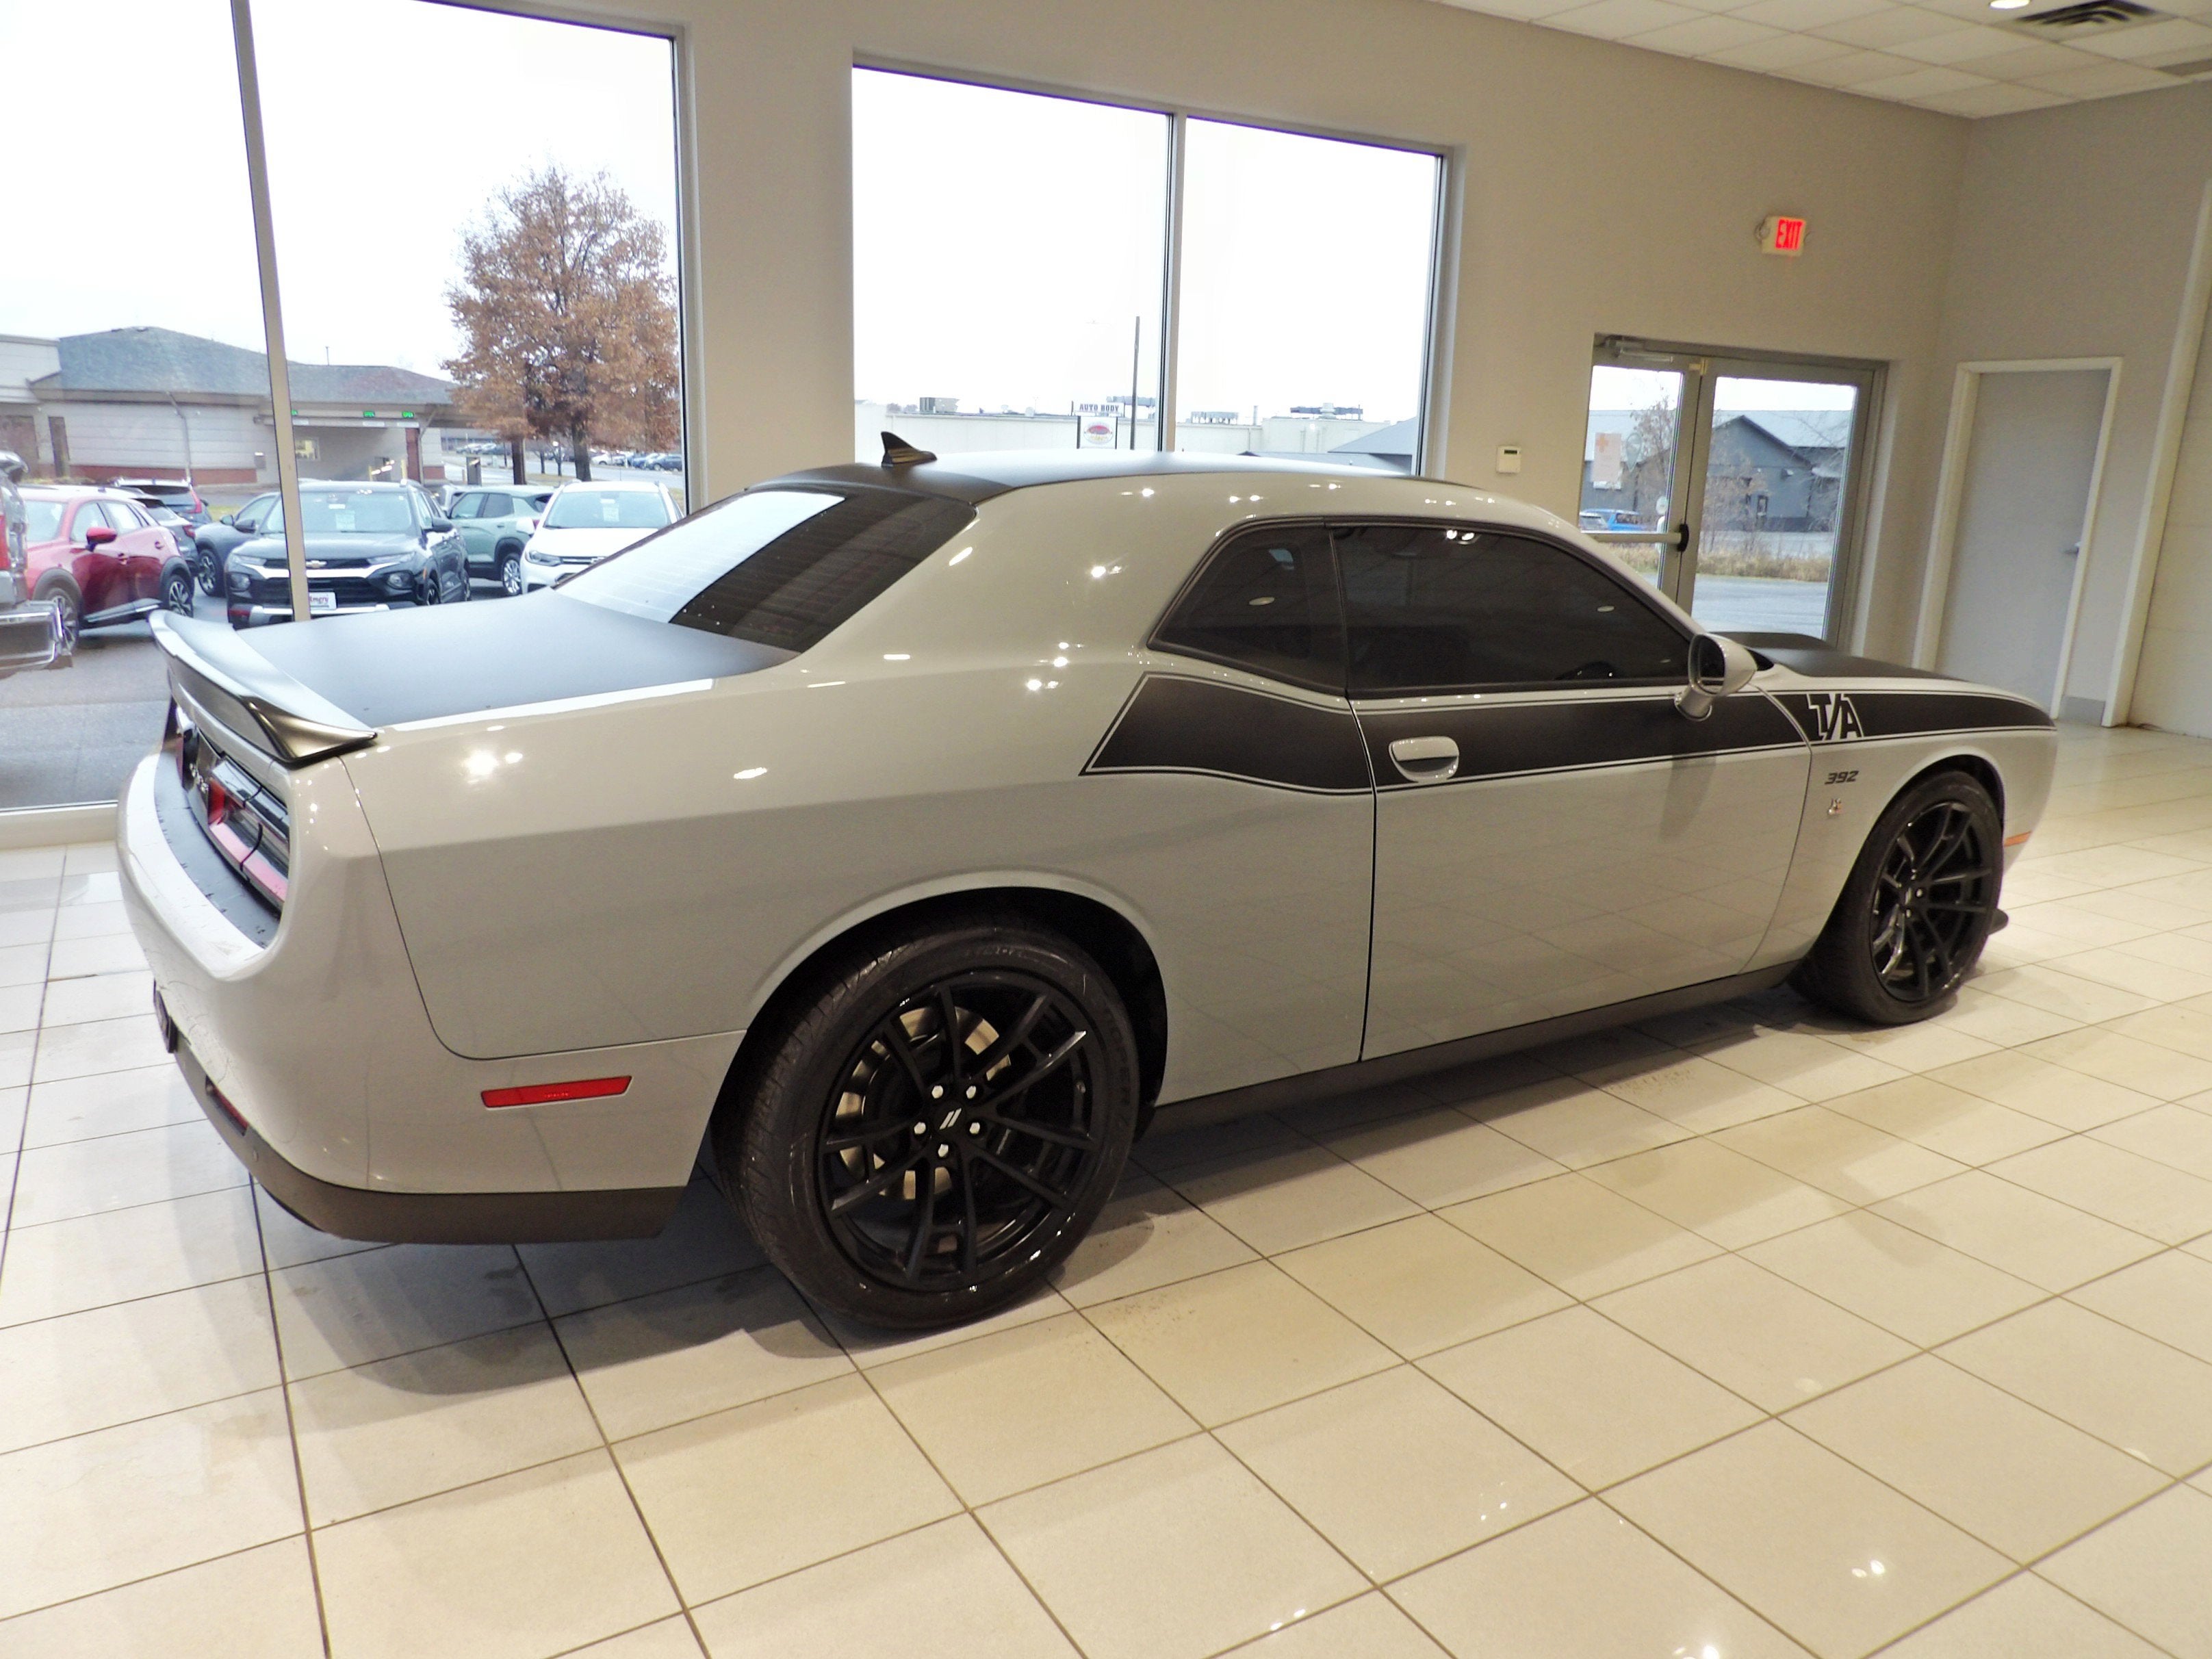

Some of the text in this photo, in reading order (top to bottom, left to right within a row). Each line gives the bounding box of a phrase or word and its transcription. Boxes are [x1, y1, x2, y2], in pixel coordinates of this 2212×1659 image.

[1775, 219, 1805, 251] EXIT
[1808, 693, 1864, 741] T/A
[1824, 770, 1860, 785] 392
